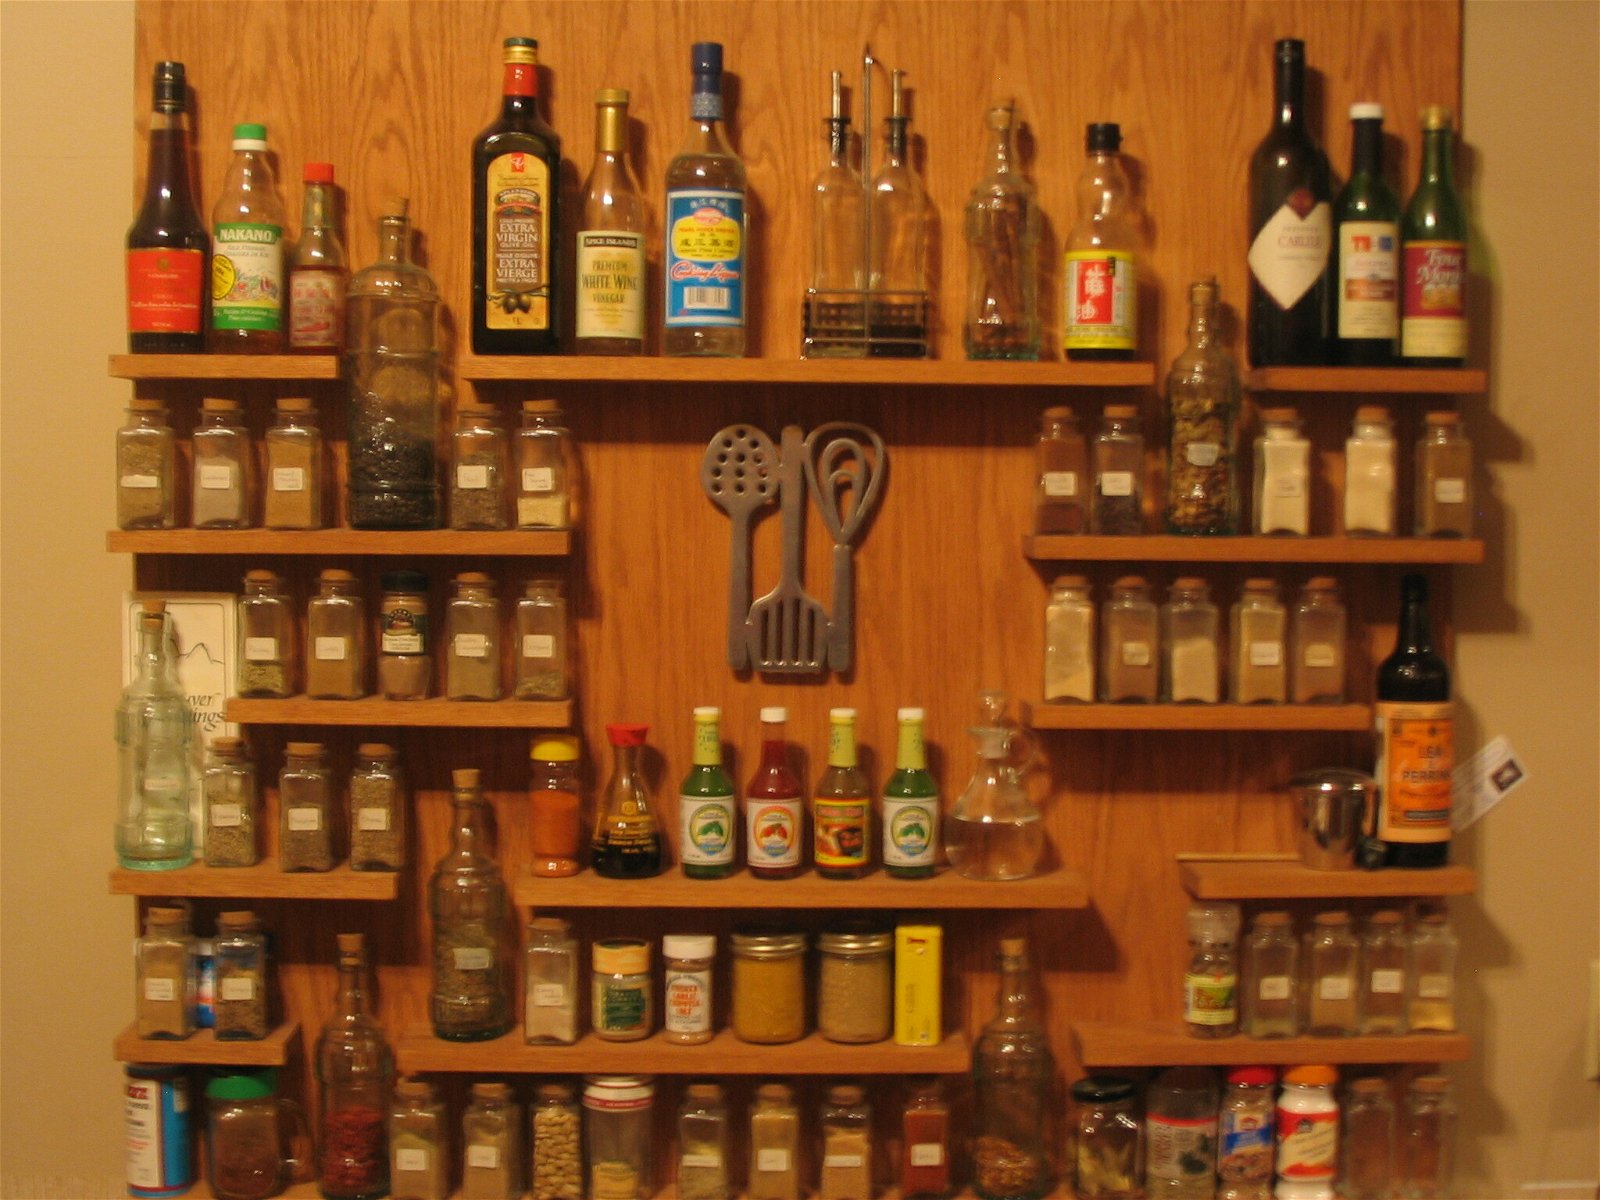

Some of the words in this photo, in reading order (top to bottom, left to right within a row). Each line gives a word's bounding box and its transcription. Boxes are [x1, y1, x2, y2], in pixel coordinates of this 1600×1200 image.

[500, 223, 535, 233] EXTRA
[220, 229, 272, 242] NAKANO
[496, 232, 539, 242] VIRGIN
[500, 259, 536, 268] EXTRA
[592, 260, 628, 271] PREMIUM
[496, 268, 538, 278] VIERGE
[582, 274, 609, 289] WHITE
[613, 275, 638, 290] WINE
[592, 293, 625, 303] VINEGAR
